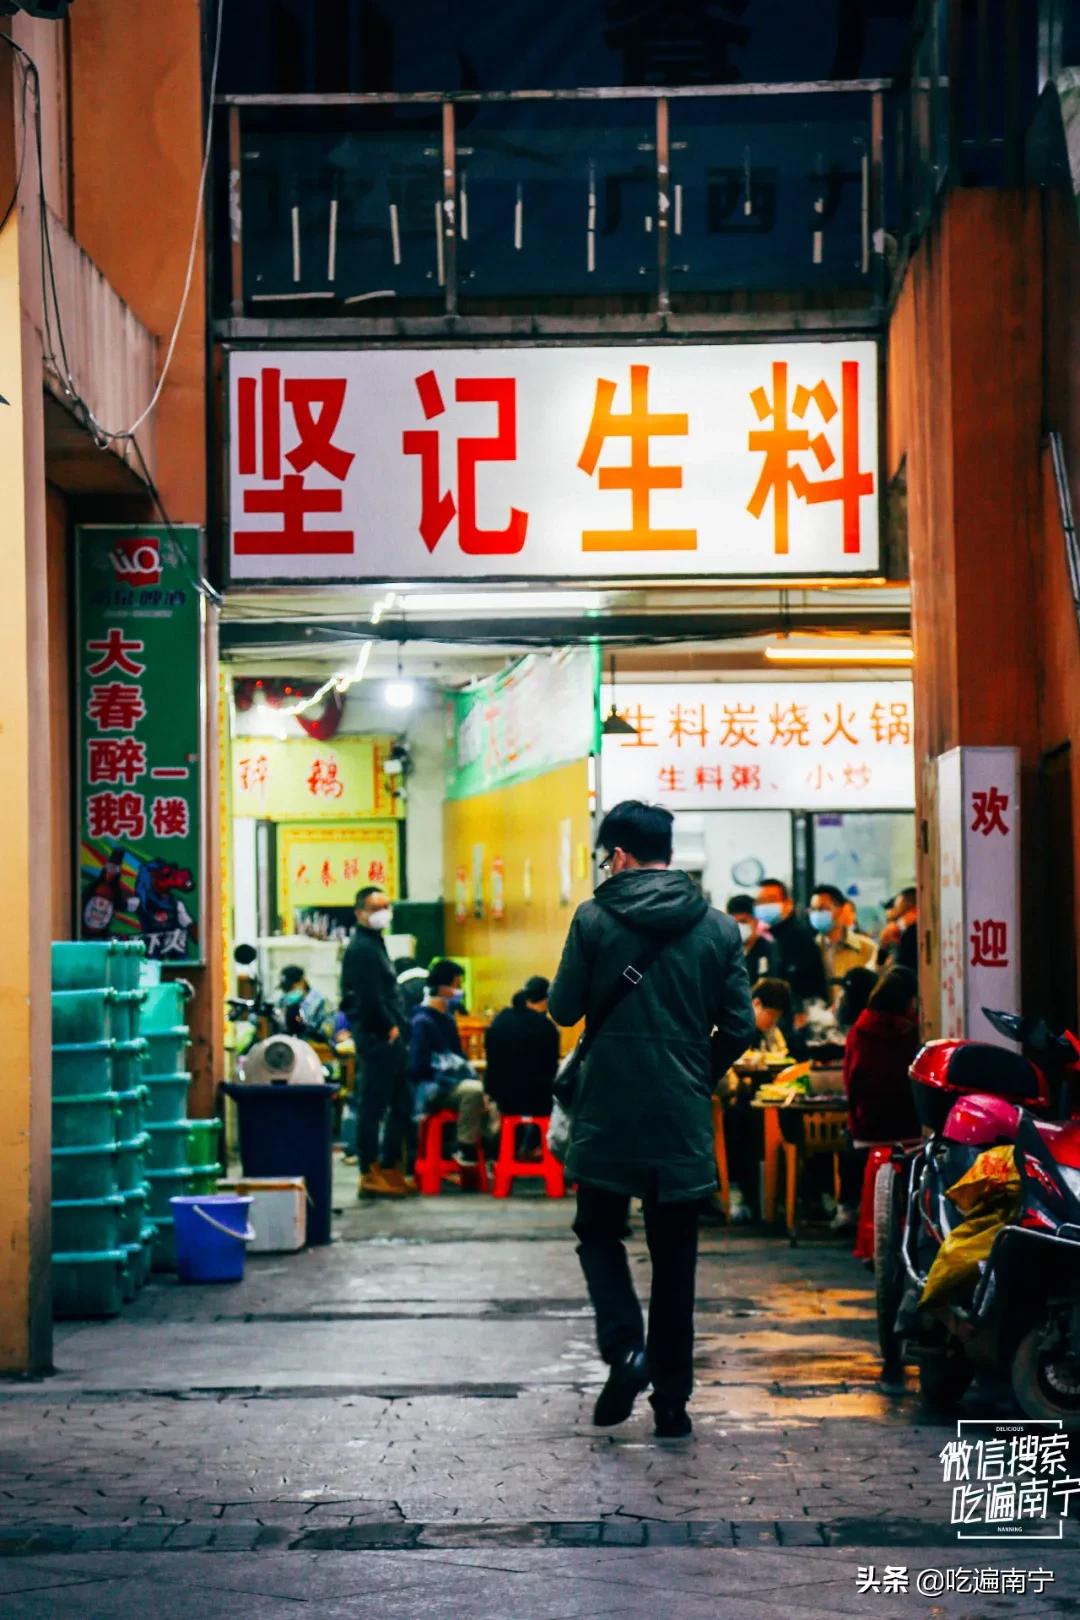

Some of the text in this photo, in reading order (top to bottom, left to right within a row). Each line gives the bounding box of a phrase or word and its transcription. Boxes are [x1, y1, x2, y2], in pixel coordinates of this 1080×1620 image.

[233, 361, 874, 554] 坚记生料
[86, 627, 146, 839] 大春醉鹅
[150, 766, 189, 838] 一楼
[620, 702, 913, 748] 生料炭烧火锅
[970, 786, 1010, 968] 欢迎
